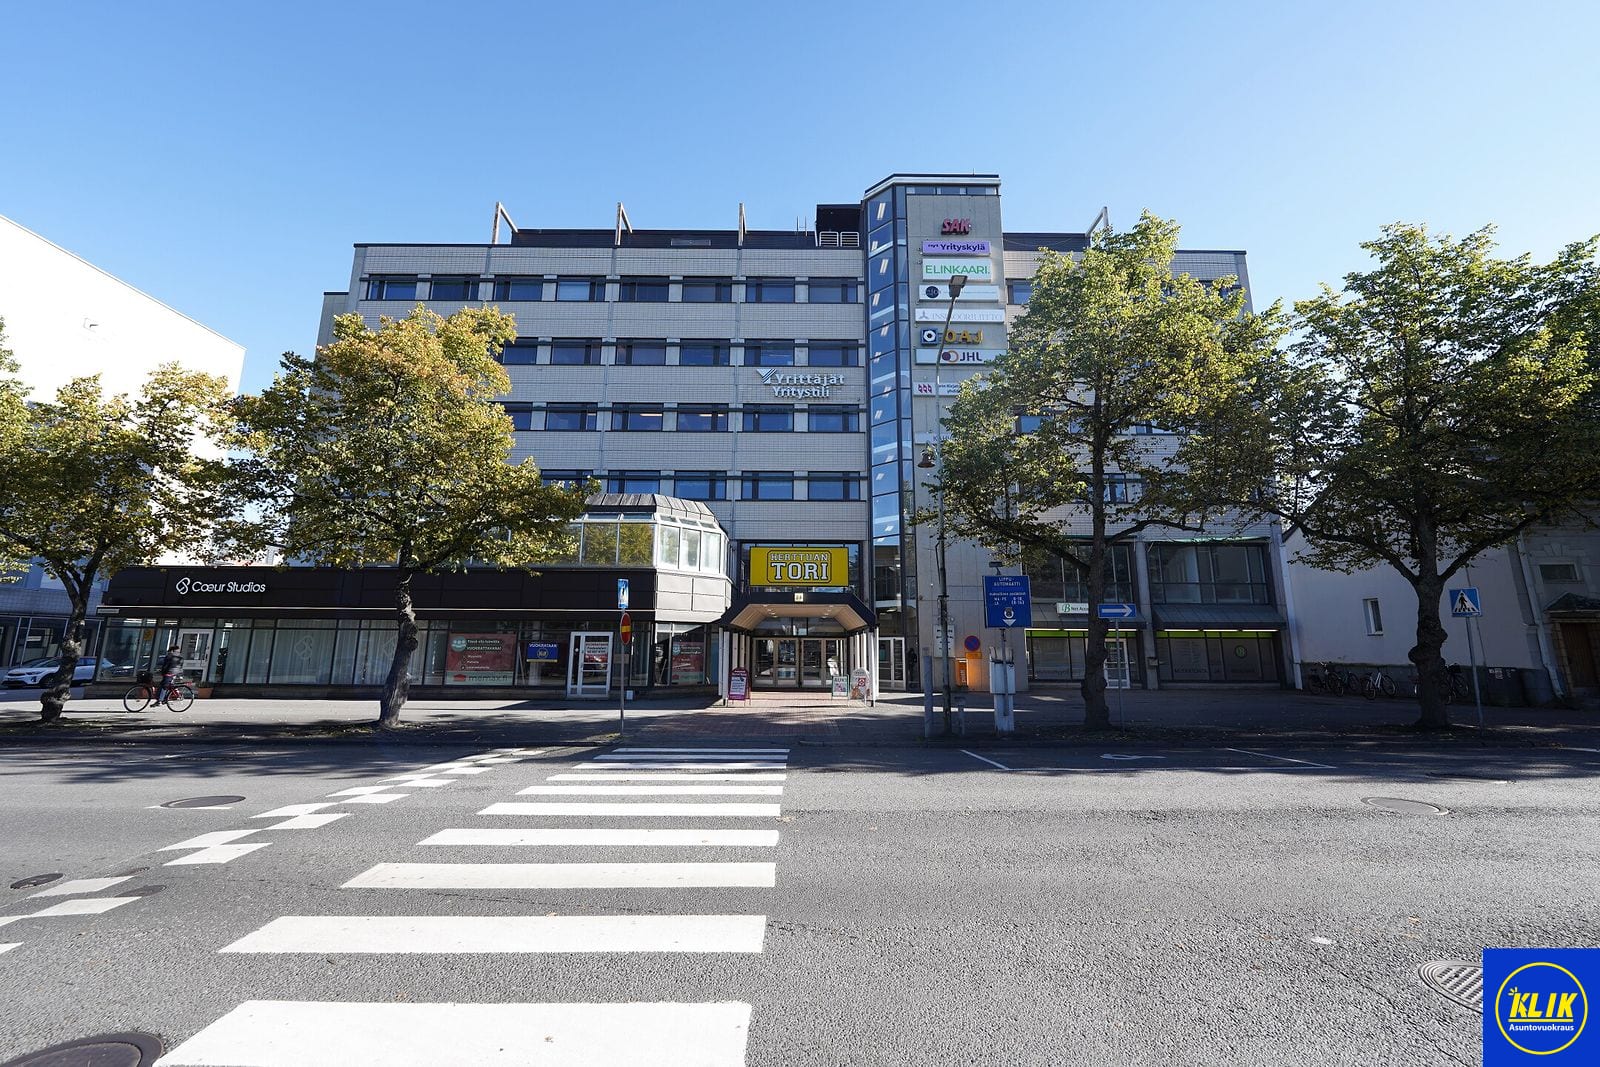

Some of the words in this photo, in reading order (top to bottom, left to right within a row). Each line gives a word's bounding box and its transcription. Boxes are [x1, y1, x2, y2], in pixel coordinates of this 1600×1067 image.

[941, 218, 970, 233] SAK
[940, 243, 986, 252] Yrityskylä
[945, 329, 984, 344] OAJ
[960, 352, 983, 361] JHL
[775, 373, 845, 386] Yrittäjät
[772, 386, 829, 399] Yritystili
[768, 552, 829, 561] HERTTUAN
[771, 562, 829, 580] TORI
[226, 581, 266, 592] Studios
